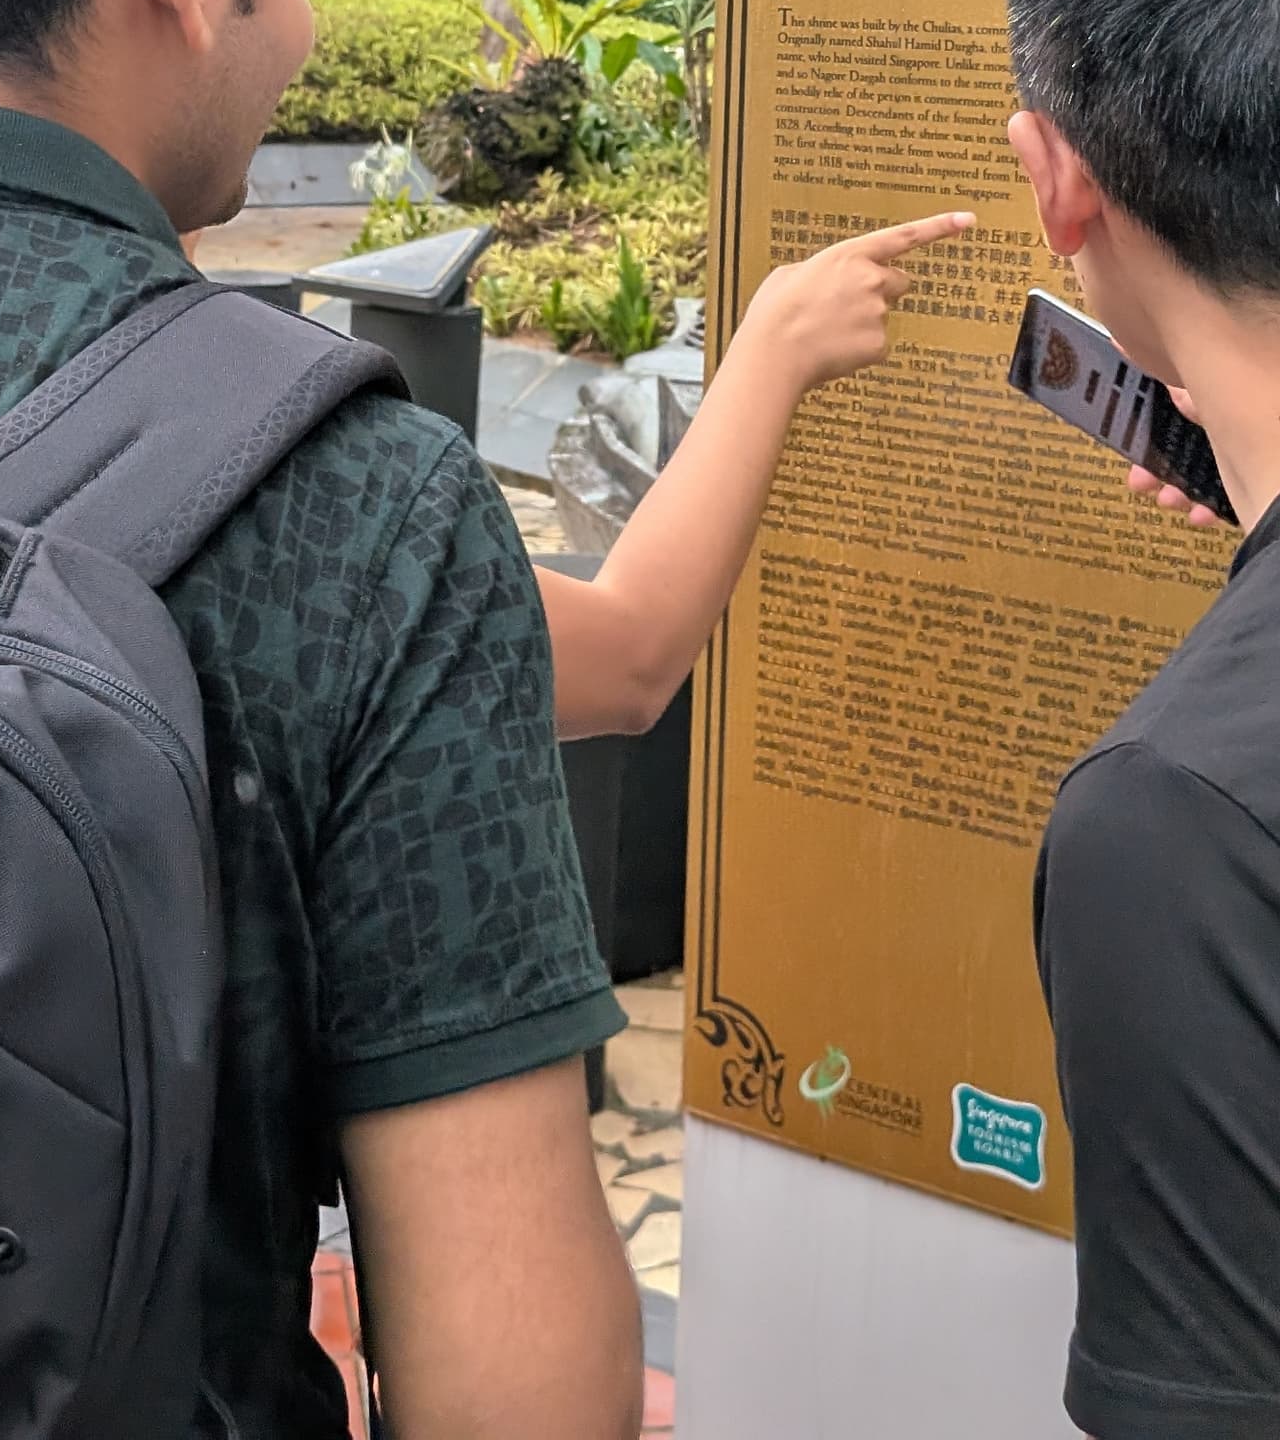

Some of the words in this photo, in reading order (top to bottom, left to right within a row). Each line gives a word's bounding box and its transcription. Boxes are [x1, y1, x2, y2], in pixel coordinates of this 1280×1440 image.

[778, 8, 805, 27] This
[808, 16, 838, 28] shrine
[841, 21, 860, 29] was
[862, 18, 886, 31] built
[889, 19, 900, 33] by
[903, 20, 920, 32] the
[967, 26, 973, 34] a
[778, 32, 826, 47] Originally
[829, 36, 863, 47] named
[866, 36, 901, 49] Shahul
[905, 38, 941, 51] Hamid
[991, 41, 1008, 54] the
[808, 51, 831, 63] who
[833, 52, 851, 64] had
[855, 54, 886, 66] visited
[946, 57, 981, 70] Unlike
[776, 67, 794, 78] and
[797, 71, 808, 79] so
[811, 68, 846, 82] Nagore
[850, 70, 885, 85] Dargah
[889, 73, 937, 87] conforms
[941, 78, 951, 87] to
[954, 76, 970, 88] the
[974, 80, 1002, 90] street
[776, 86, 789, 95] no
[792, 84, 820, 99] bodily
[824, 86, 843, 98] relic
[847, 87, 858, 99] of
[860, 88, 874, 100] the
[878, 92, 911, 104] person
[846, 104, 914, 120] Descendants
[918, 109, 930, 121] of
[932, 110, 950, 123] the
[954, 111, 997, 126] founder
[804, 119, 854, 136] According
[856, 125, 867, 133] to
[899, 126, 915, 138] the
[919, 128, 951, 141] shrine
[953, 132, 973, 142] was
[976, 132, 986, 144] in
[775, 134, 793, 148] The
[797, 135, 816, 148] first
[819, 138, 849, 151] shrine
[853, 143, 873, 153] was
[876, 143, 905, 156] made
[907, 144, 933, 158] from
[936, 148, 968, 161] wood
[972, 150, 991, 162] and
[774, 156, 800, 167] again
[804, 156, 814, 166] in
[846, 158, 870, 171] with
[874, 160, 924, 175] materials
[927, 166, 979, 181] imported
[983, 167, 1010, 182] from
[773, 170, 788, 182] the
[793, 171, 824, 185] oldest
[827, 174, 872, 189] religious
[875, 180, 936, 194] monument
[940, 184, 950, 195] in
